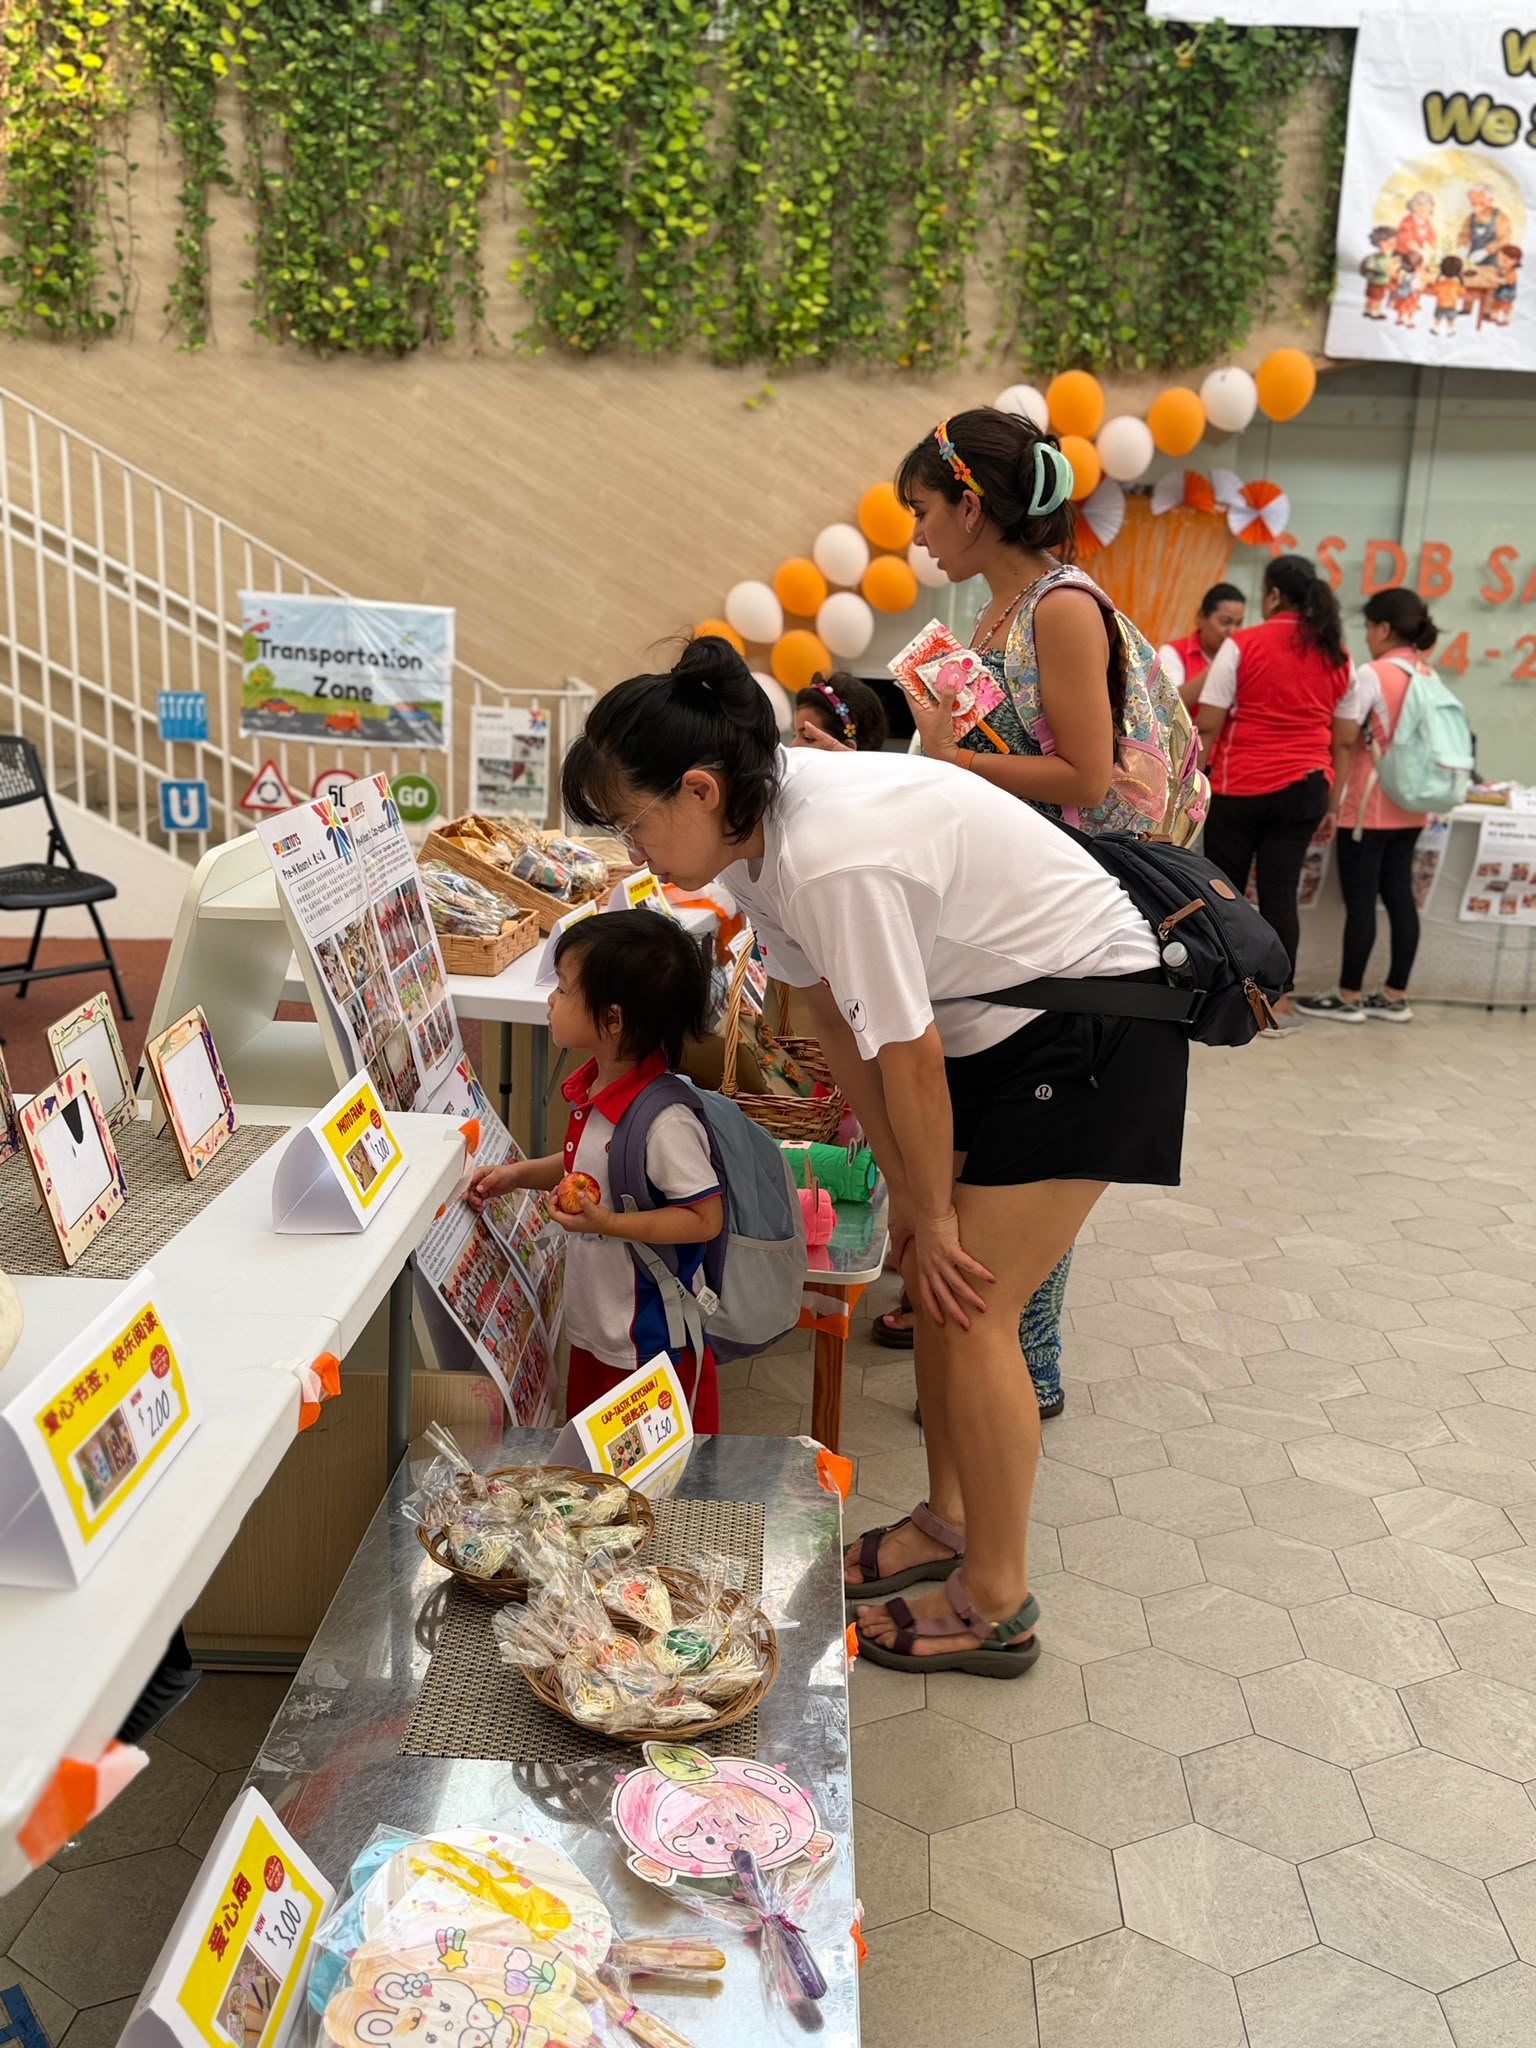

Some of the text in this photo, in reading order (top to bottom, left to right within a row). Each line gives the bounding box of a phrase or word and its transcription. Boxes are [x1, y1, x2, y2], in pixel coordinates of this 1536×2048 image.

[1422, 90, 1522, 147] We
[256, 638, 423, 670] Transportation
[312, 676, 373, 702] Zone
[168, 786, 200, 828] U
[397, 785, 429, 809] GO
[335, 1097, 367, 1136] PHOTO FRAME
[601, 1397, 632, 1425] CAP-TASTIC
[630, 1379, 656, 1404] KEYCHAIN
[207, 1870, 253, 1963] 爱心扇
[253, 1912, 267, 1937] NOW
